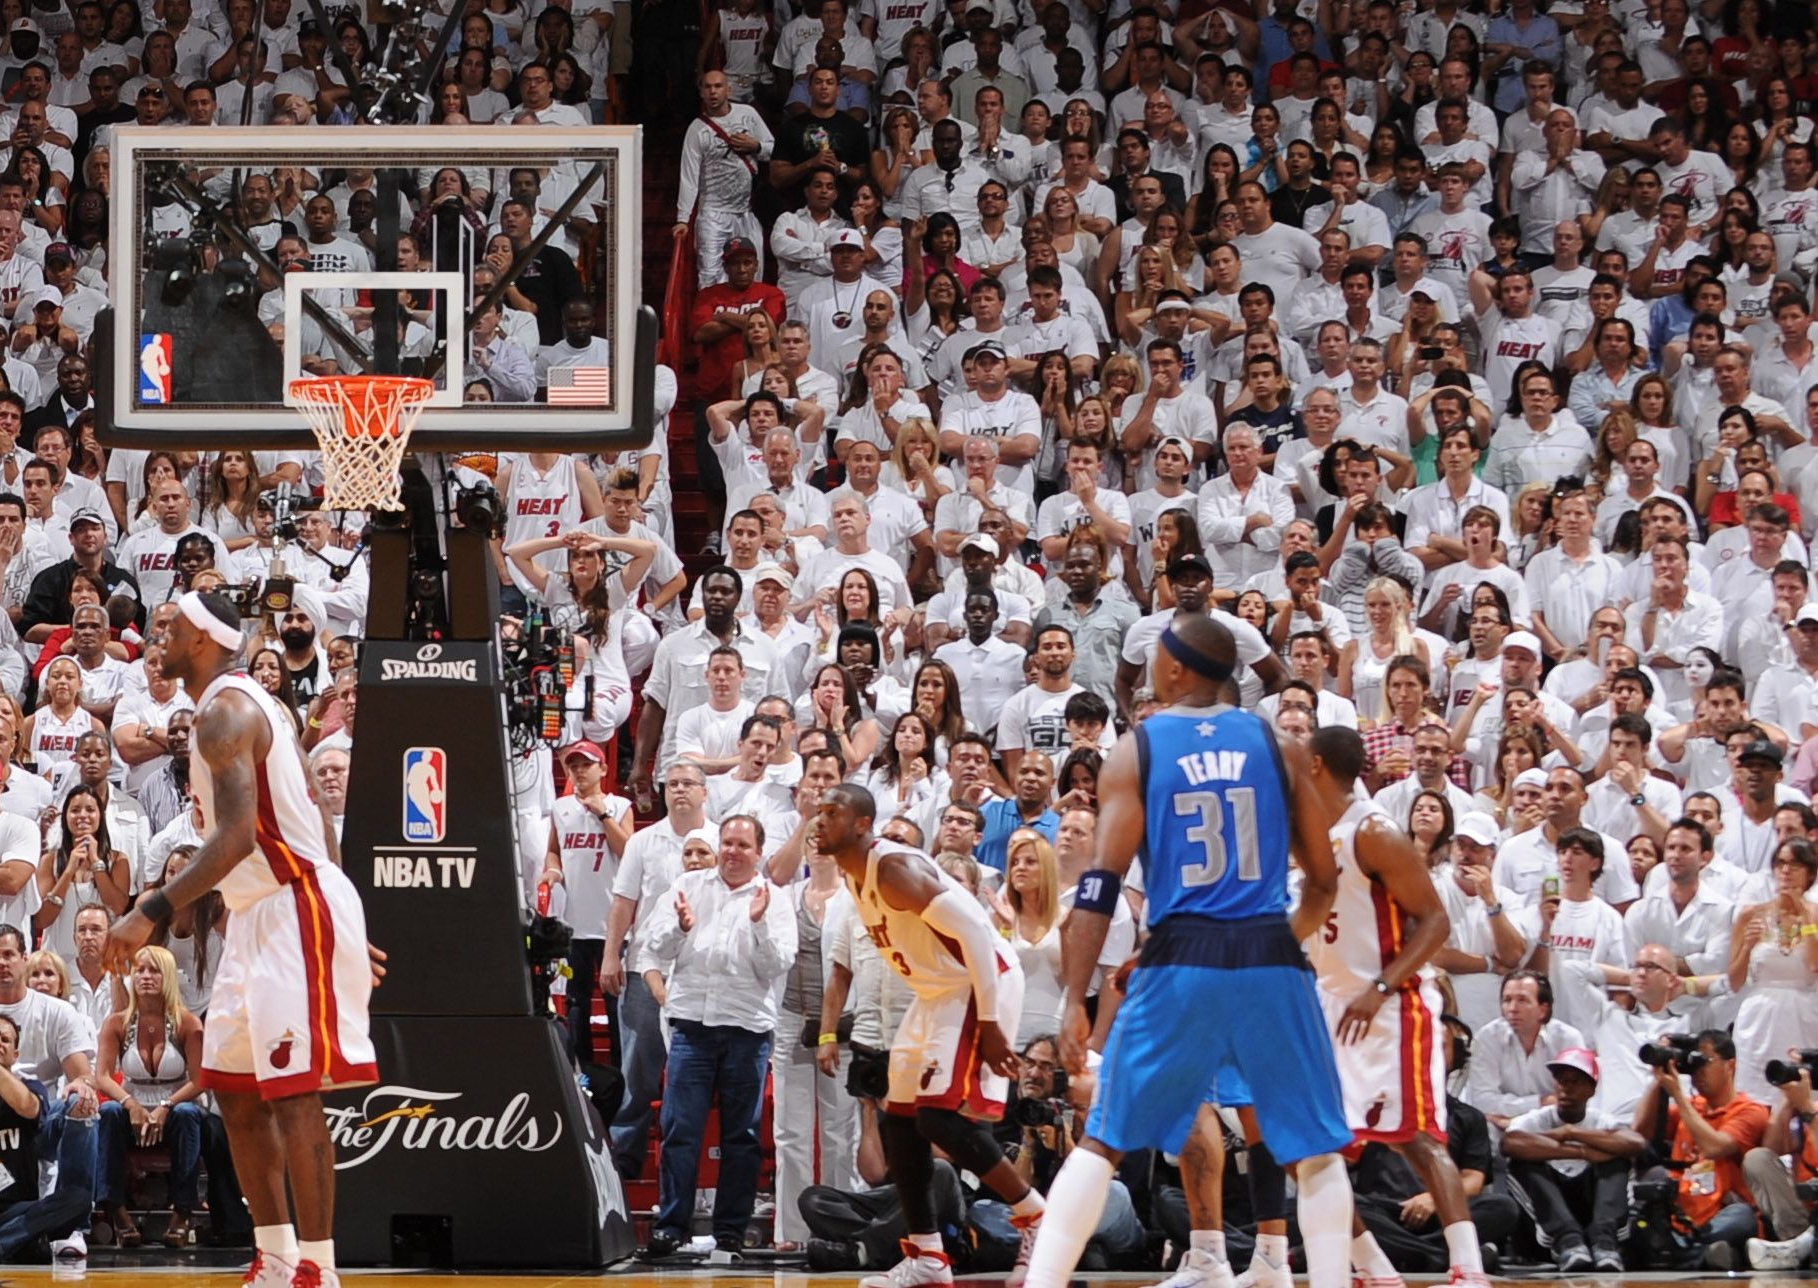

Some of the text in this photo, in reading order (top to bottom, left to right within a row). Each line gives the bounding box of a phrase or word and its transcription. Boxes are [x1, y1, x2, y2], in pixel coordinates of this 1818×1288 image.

[886, 2, 928, 21] HEAT
[729, 28, 763, 42] HEAT
[1496, 342, 1546, 361] HEAT
[517, 494, 568, 516] HEAT
[544, 521, 560, 538] 3
[139, 554, 176, 572] HEA
[381, 659, 478, 682] SPALDING
[1176, 750, 1248, 787] TERRY
[408, 822, 432, 836] NBA
[1173, 786, 1262, 888] 31
[563, 832, 608, 850] HEAT
[373, 857, 477, 889] NBA TV
[593, 852, 604, 874] 1
[1080, 877, 1103, 903] 31
[893, 952, 911, 976] 3
[323, 1085, 563, 1171] The Finals
